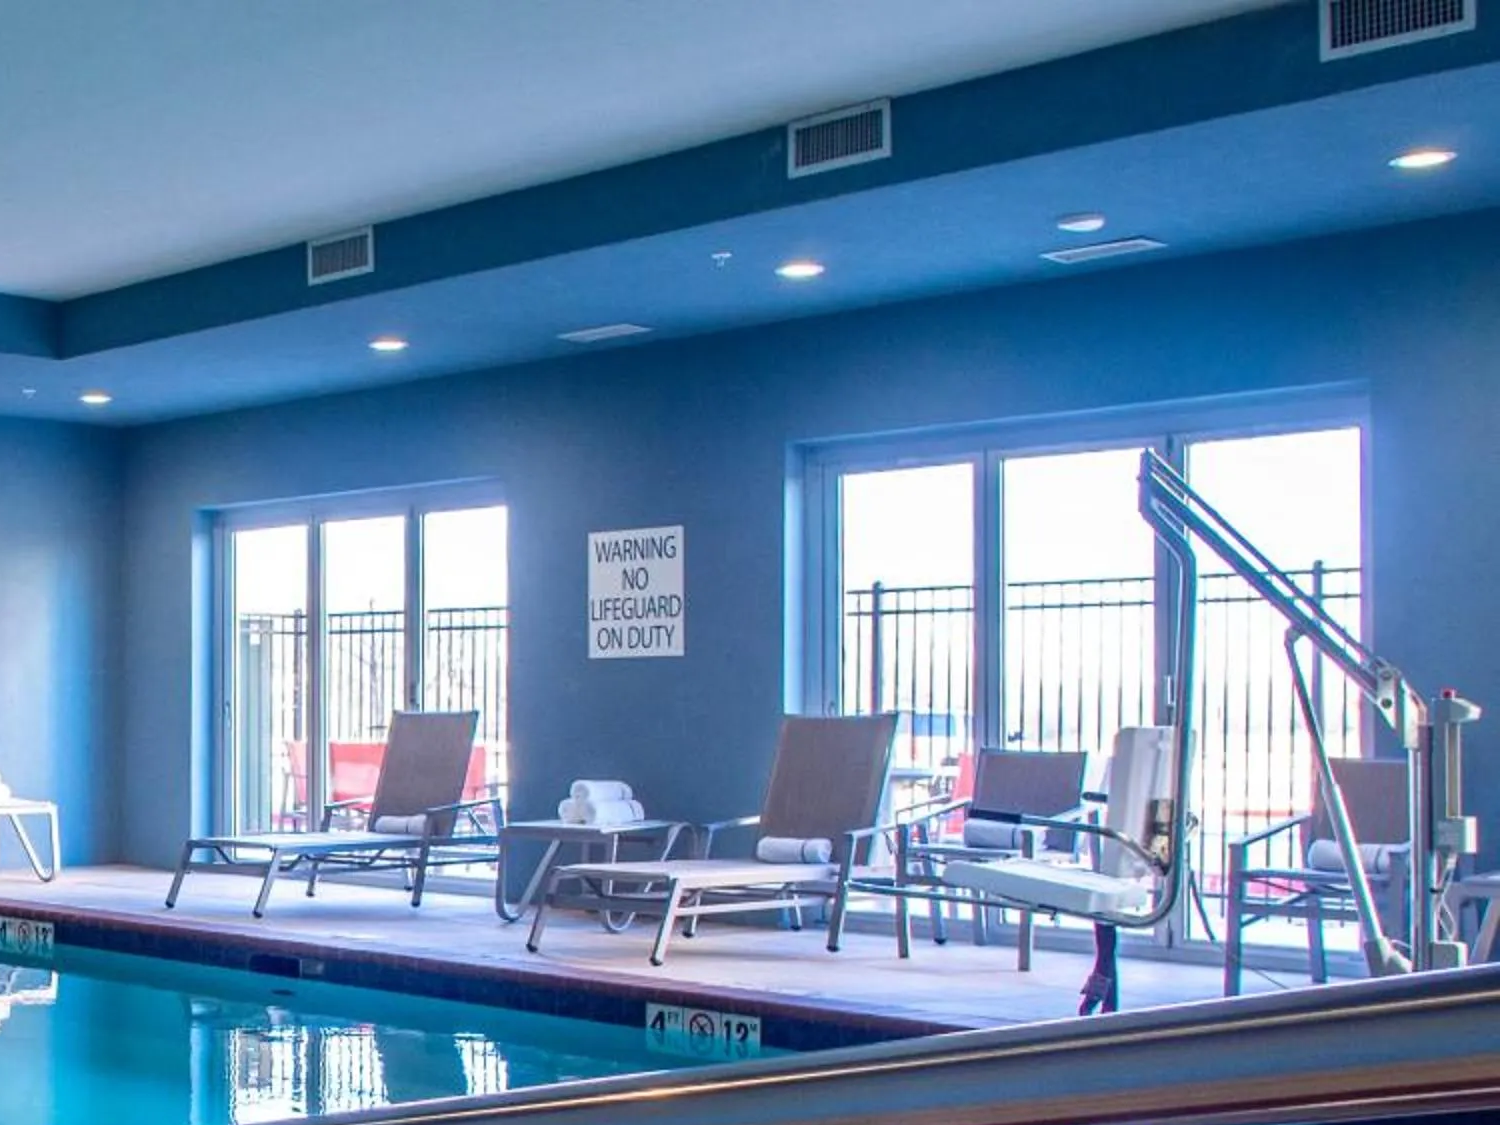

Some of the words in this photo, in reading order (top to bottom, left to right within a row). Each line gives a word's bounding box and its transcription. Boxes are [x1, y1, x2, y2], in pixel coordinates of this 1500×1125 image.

[595, 535, 677, 563] WARNING
[622, 567, 649, 590] NO
[591, 594, 682, 621] LIFEGUARD
[597, 626, 622, 650] ON
[627, 624, 675, 649] DUTY
[651, 1010, 665, 1030] 4
